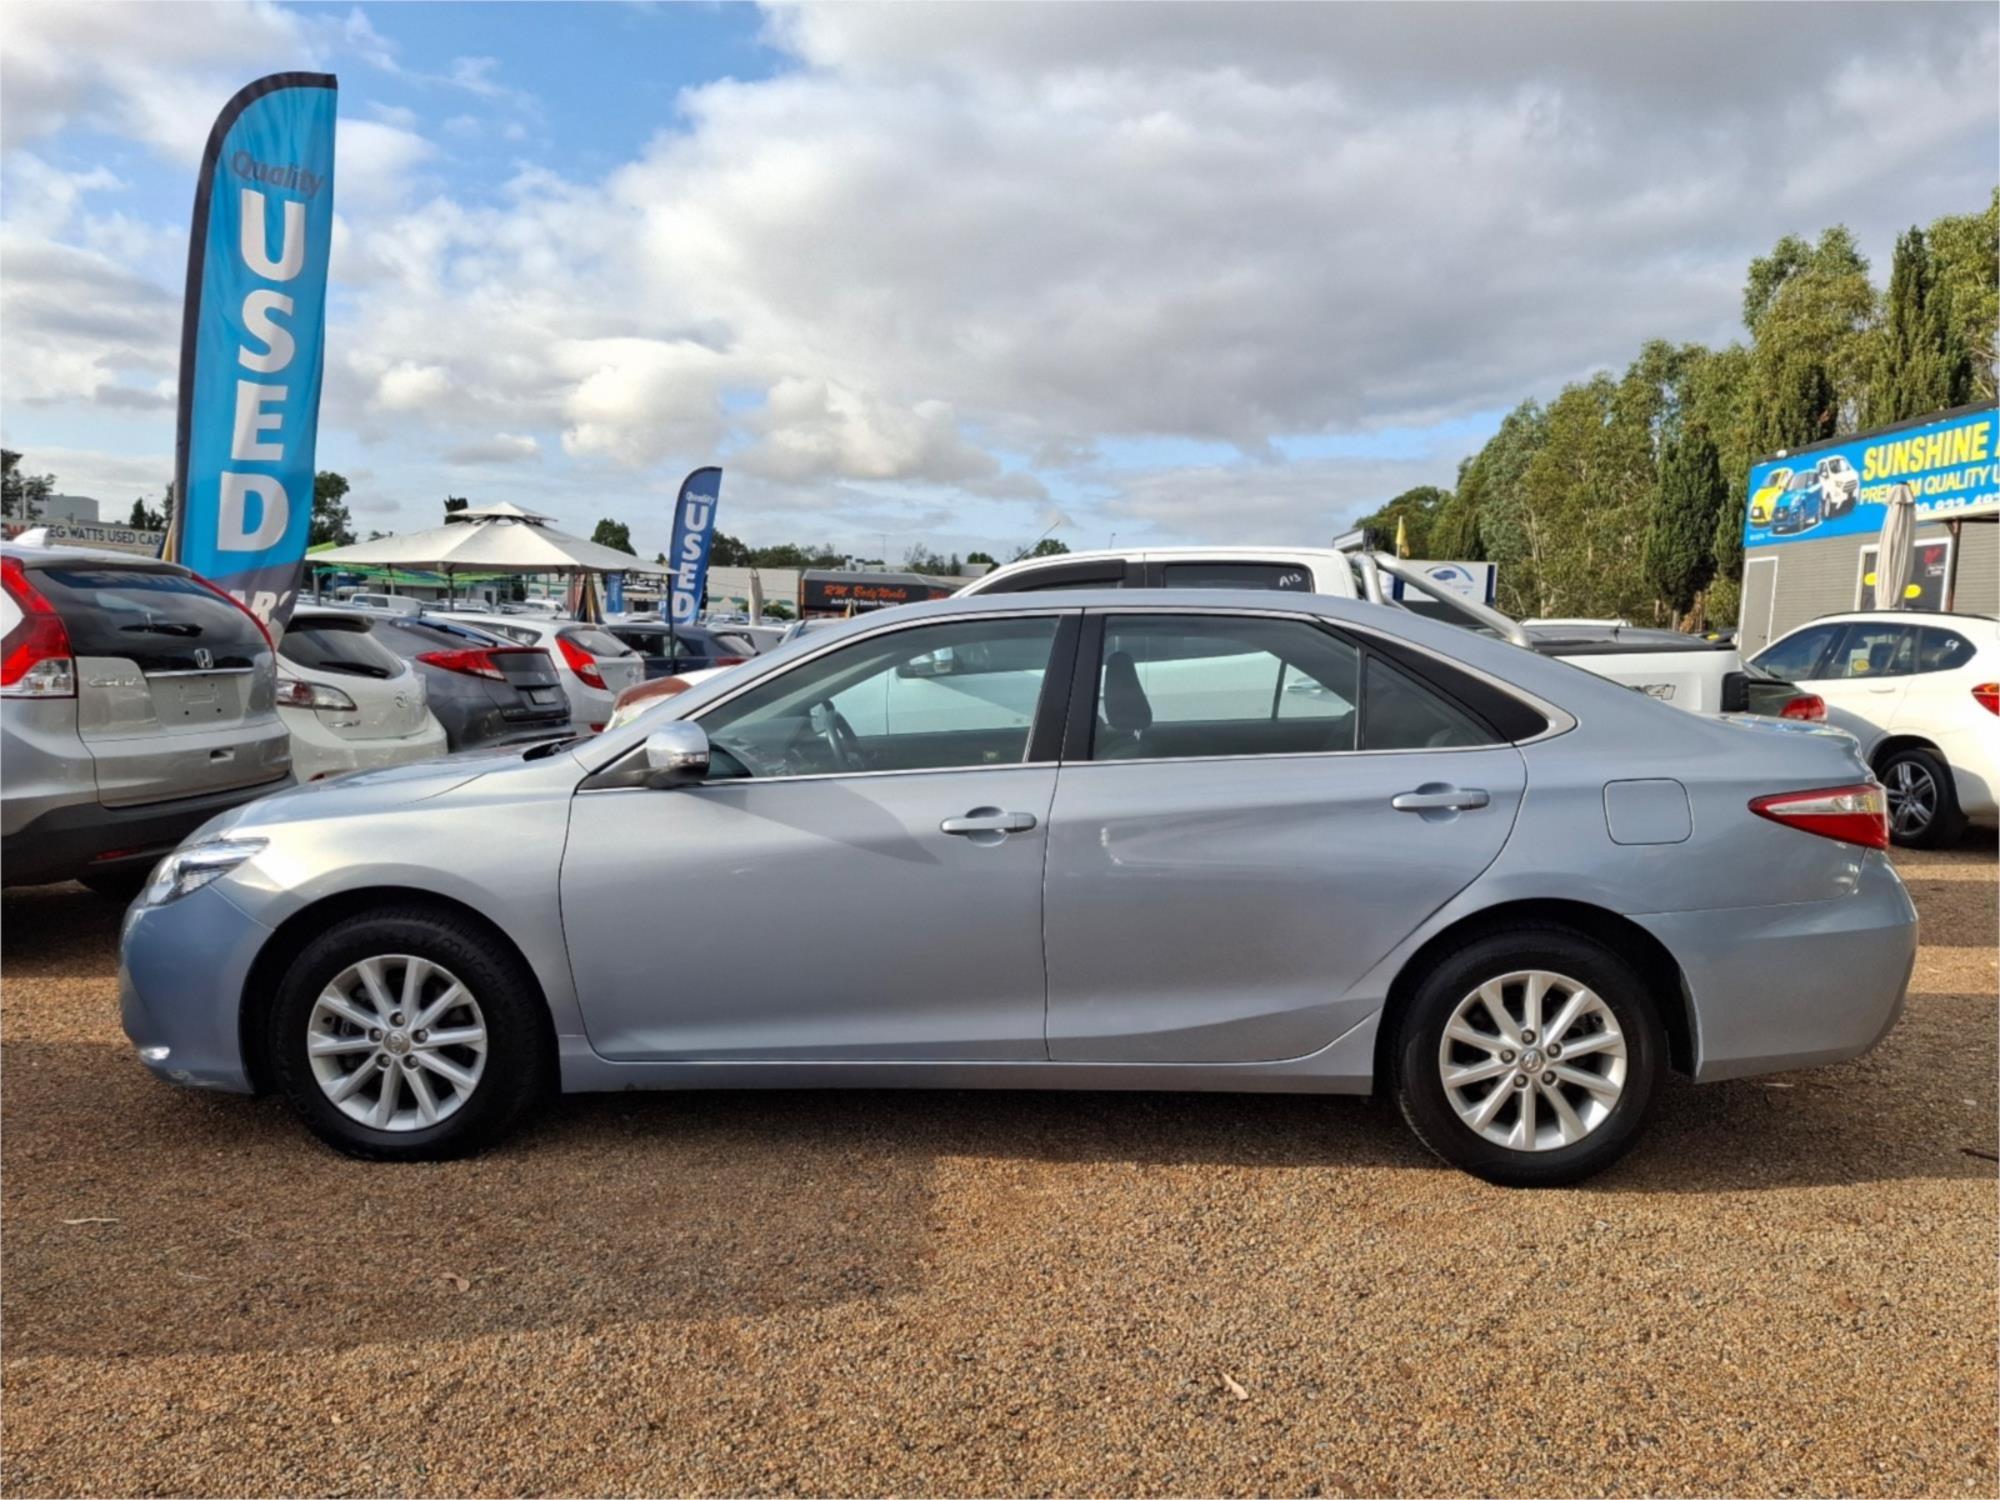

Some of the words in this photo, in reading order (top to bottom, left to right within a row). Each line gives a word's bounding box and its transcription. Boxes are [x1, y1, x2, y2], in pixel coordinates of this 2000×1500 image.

[232, 150, 325, 200] Quality
[215, 187, 306, 553] USED
[1862, 420, 1991, 482] SUNSHINE
[1924, 464, 1992, 496] QUALITY
[69, 526, 105, 541] WATTS
[107, 530, 135, 544] USED
[672, 502, 709, 618] USED
